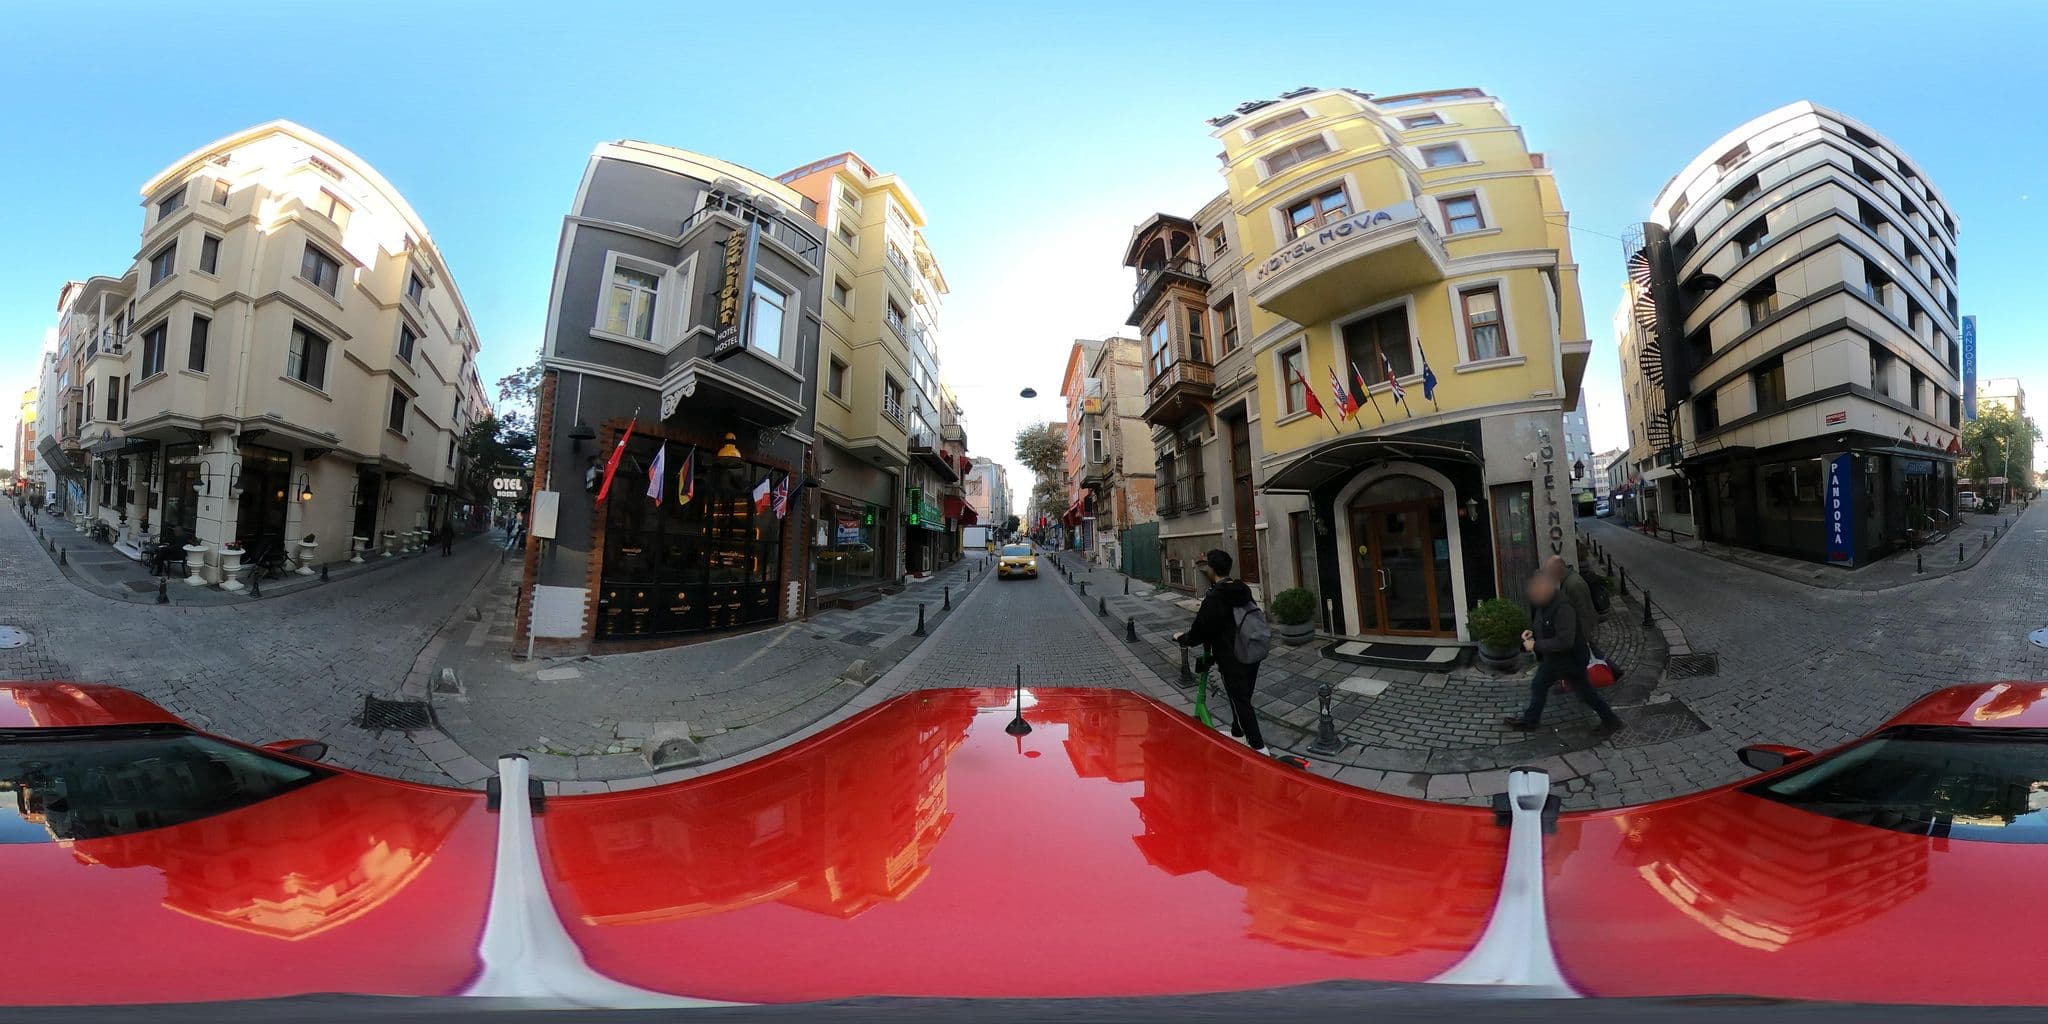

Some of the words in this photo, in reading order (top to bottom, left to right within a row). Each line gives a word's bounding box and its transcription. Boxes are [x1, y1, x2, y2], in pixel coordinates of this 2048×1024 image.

[1257, 241, 1315, 280] HOTEL
[1319, 211, 1392, 246] NOVA
[715, 336, 738, 353] HOSTEL
[718, 325, 737, 341] HOTEL
[1965, 323, 1974, 374] PANDORA
[493, 478, 522, 490] OTEL
[1539, 428, 1557, 506] HOTEL
[1549, 511, 1563, 556] NOV
[1831, 463, 1842, 544] PANDORA
